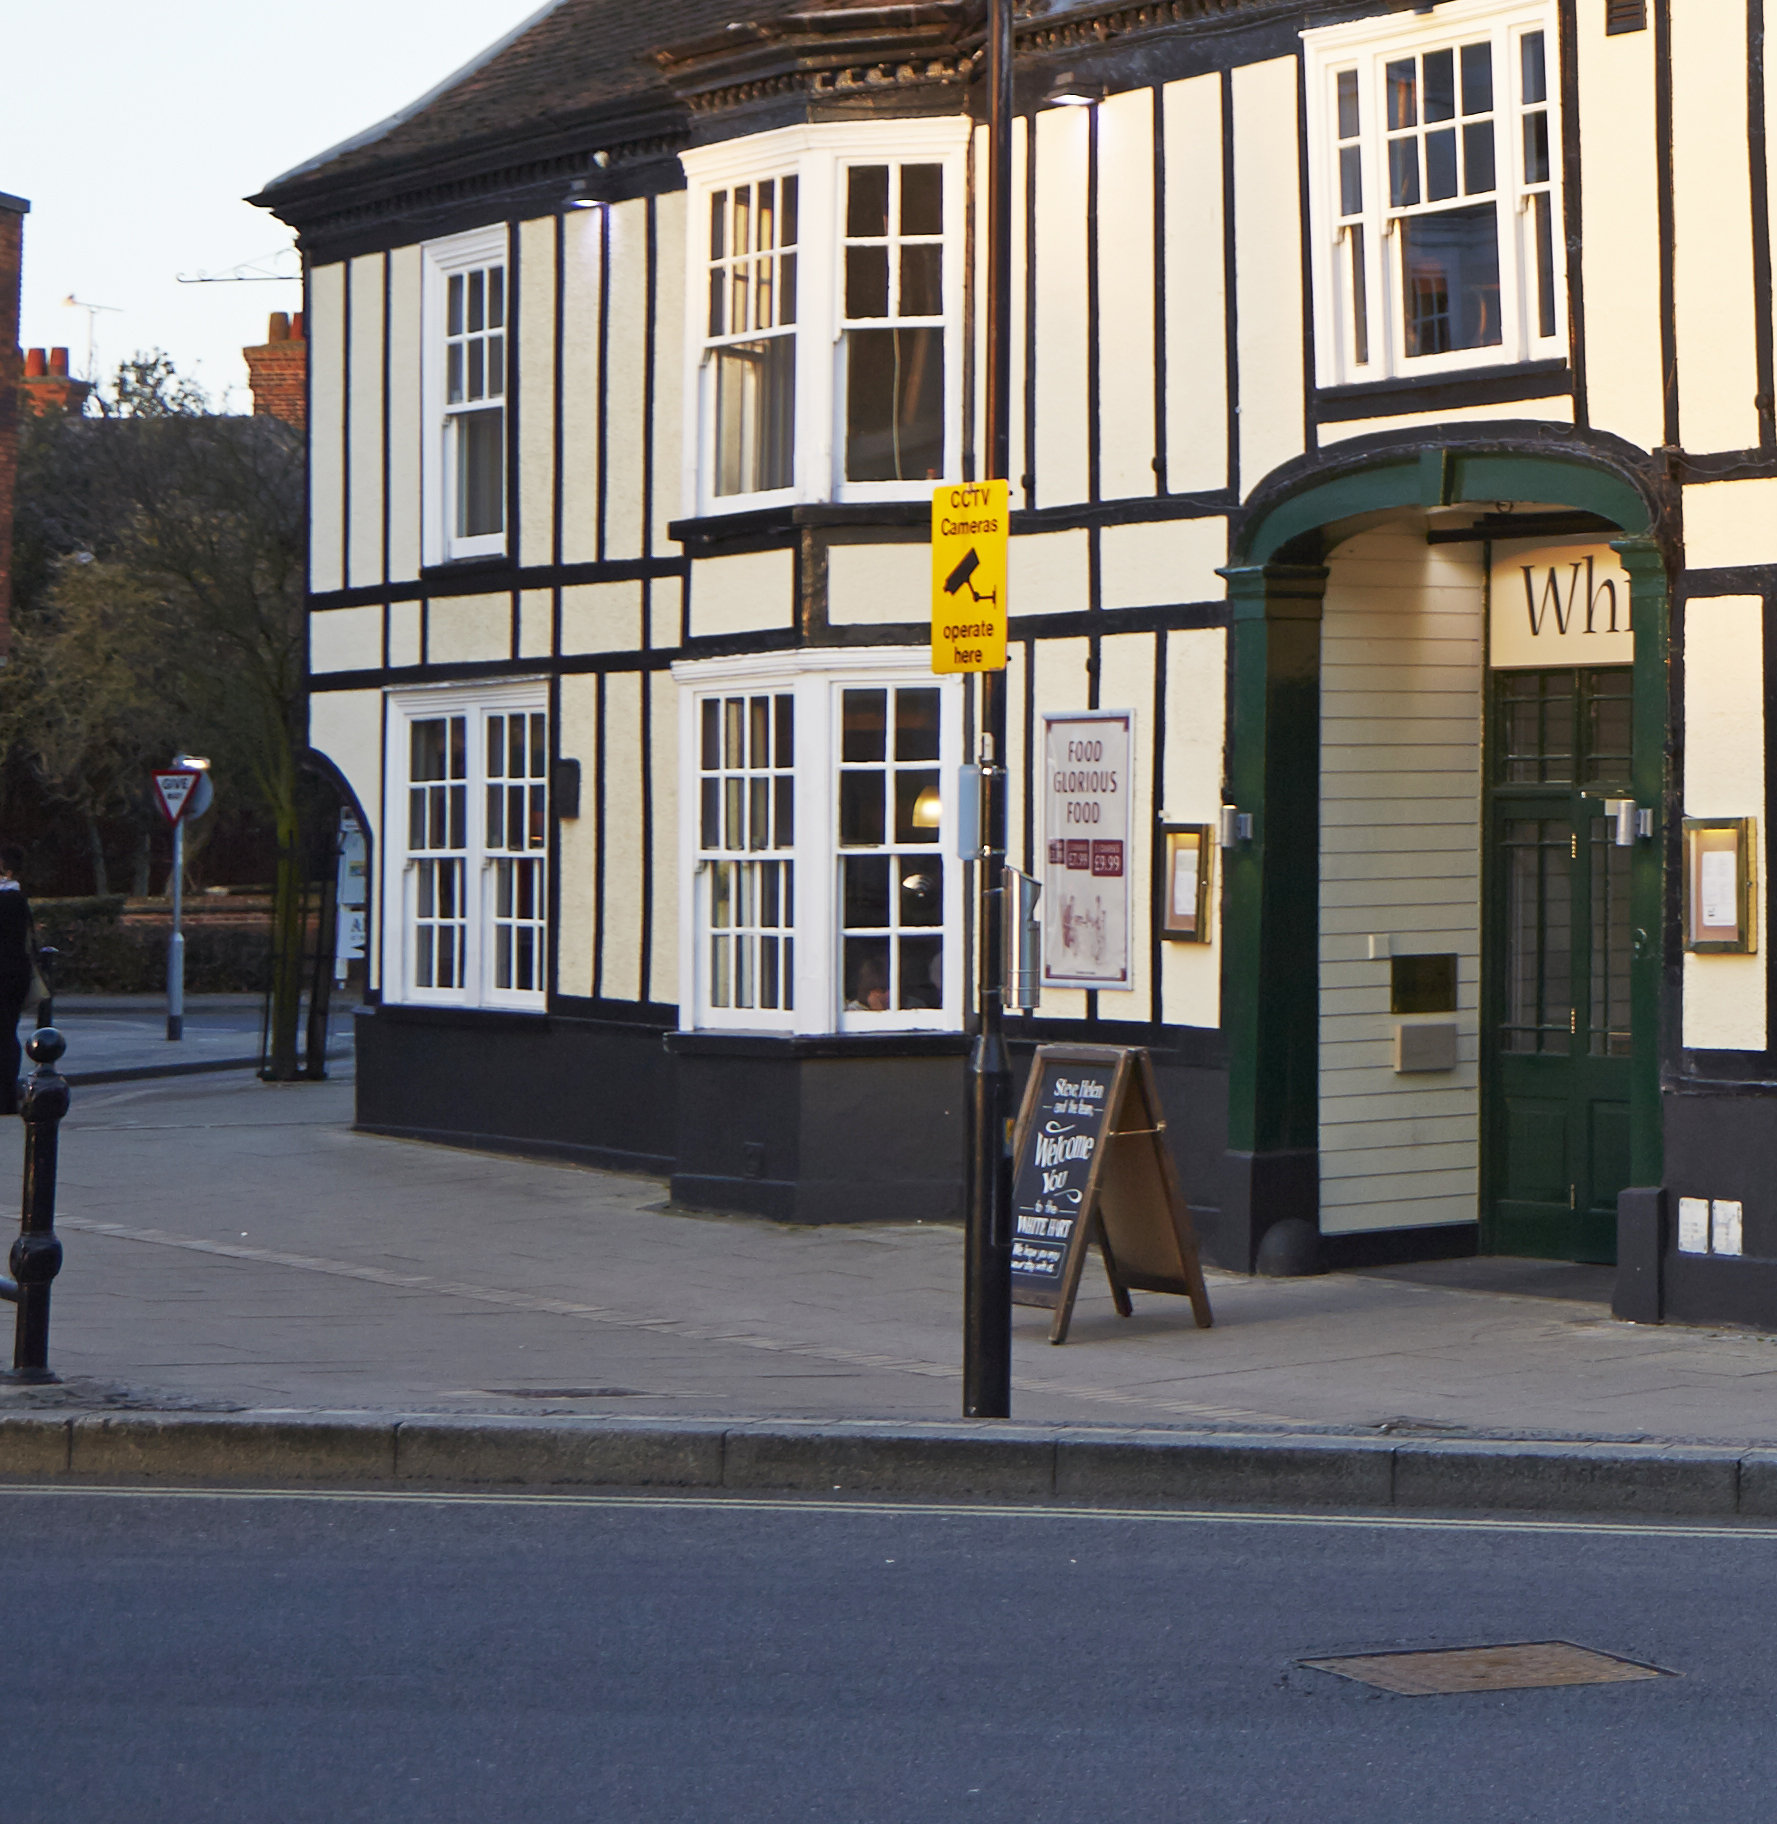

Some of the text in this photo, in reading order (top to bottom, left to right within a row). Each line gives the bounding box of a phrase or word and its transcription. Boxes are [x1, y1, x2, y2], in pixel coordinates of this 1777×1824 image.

[950, 488, 991, 509] CCTV
[941, 518, 998, 537] Cameras
[943, 621, 994, 643] operate
[954, 647, 982, 664] here
[1068, 740, 1103, 763] FOOD
[1053, 771, 1118, 793] GLORIOUS
[1067, 802, 1100, 824] FOOD
[1034, 1132, 1095, 1168] Welcome
[1017, 1215, 1049, 1236] WHITE
